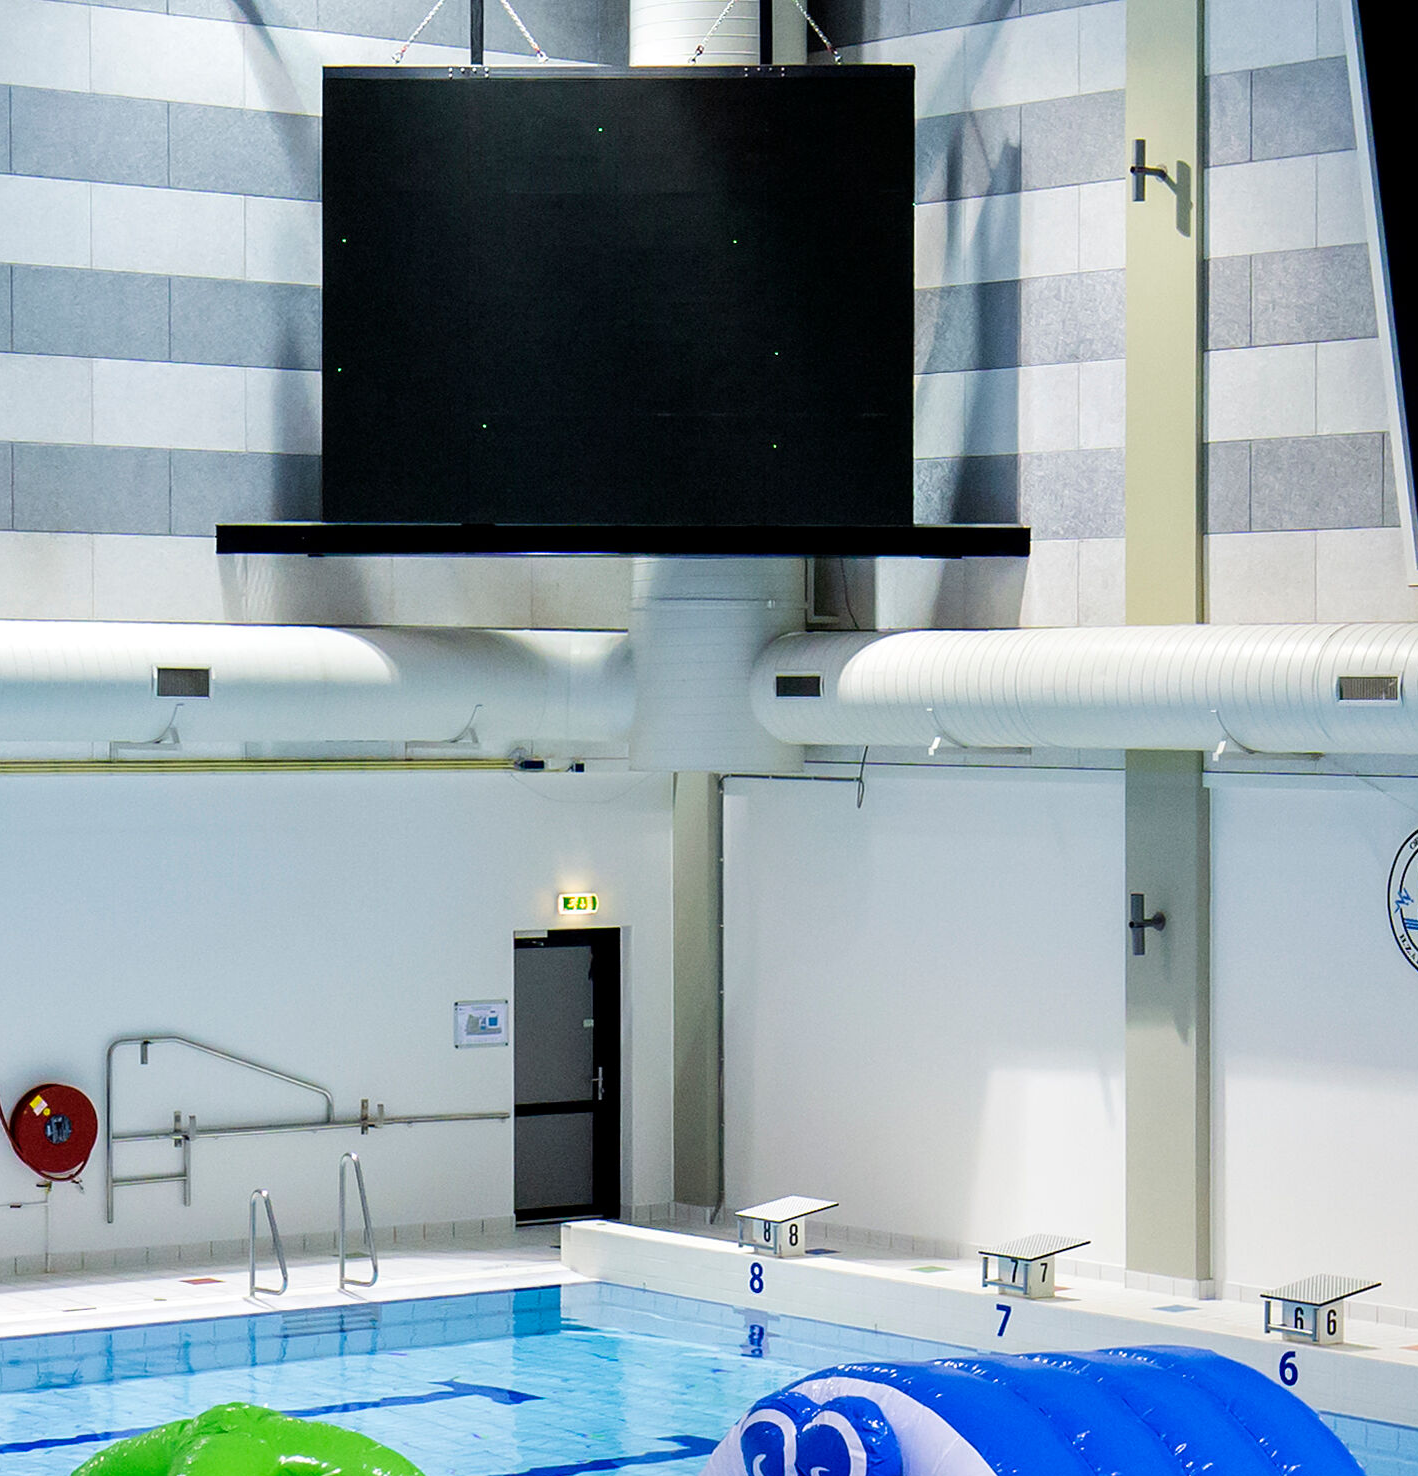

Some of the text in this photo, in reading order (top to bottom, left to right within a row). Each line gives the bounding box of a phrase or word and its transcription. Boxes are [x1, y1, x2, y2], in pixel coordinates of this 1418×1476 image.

[763, 1219, 771, 1242] 8
[789, 1223, 798, 1247] 8
[749, 1262, 764, 1294] 8
[1011, 1257, 1019, 1283] 7
[1040, 1262, 1048, 1283] 7
[996, 1303, 1012, 1337] 7
[1294, 1306, 1304, 1330] 6
[1327, 1309, 1337, 1336] 6
[1279, 1350, 1298, 1387] 6
